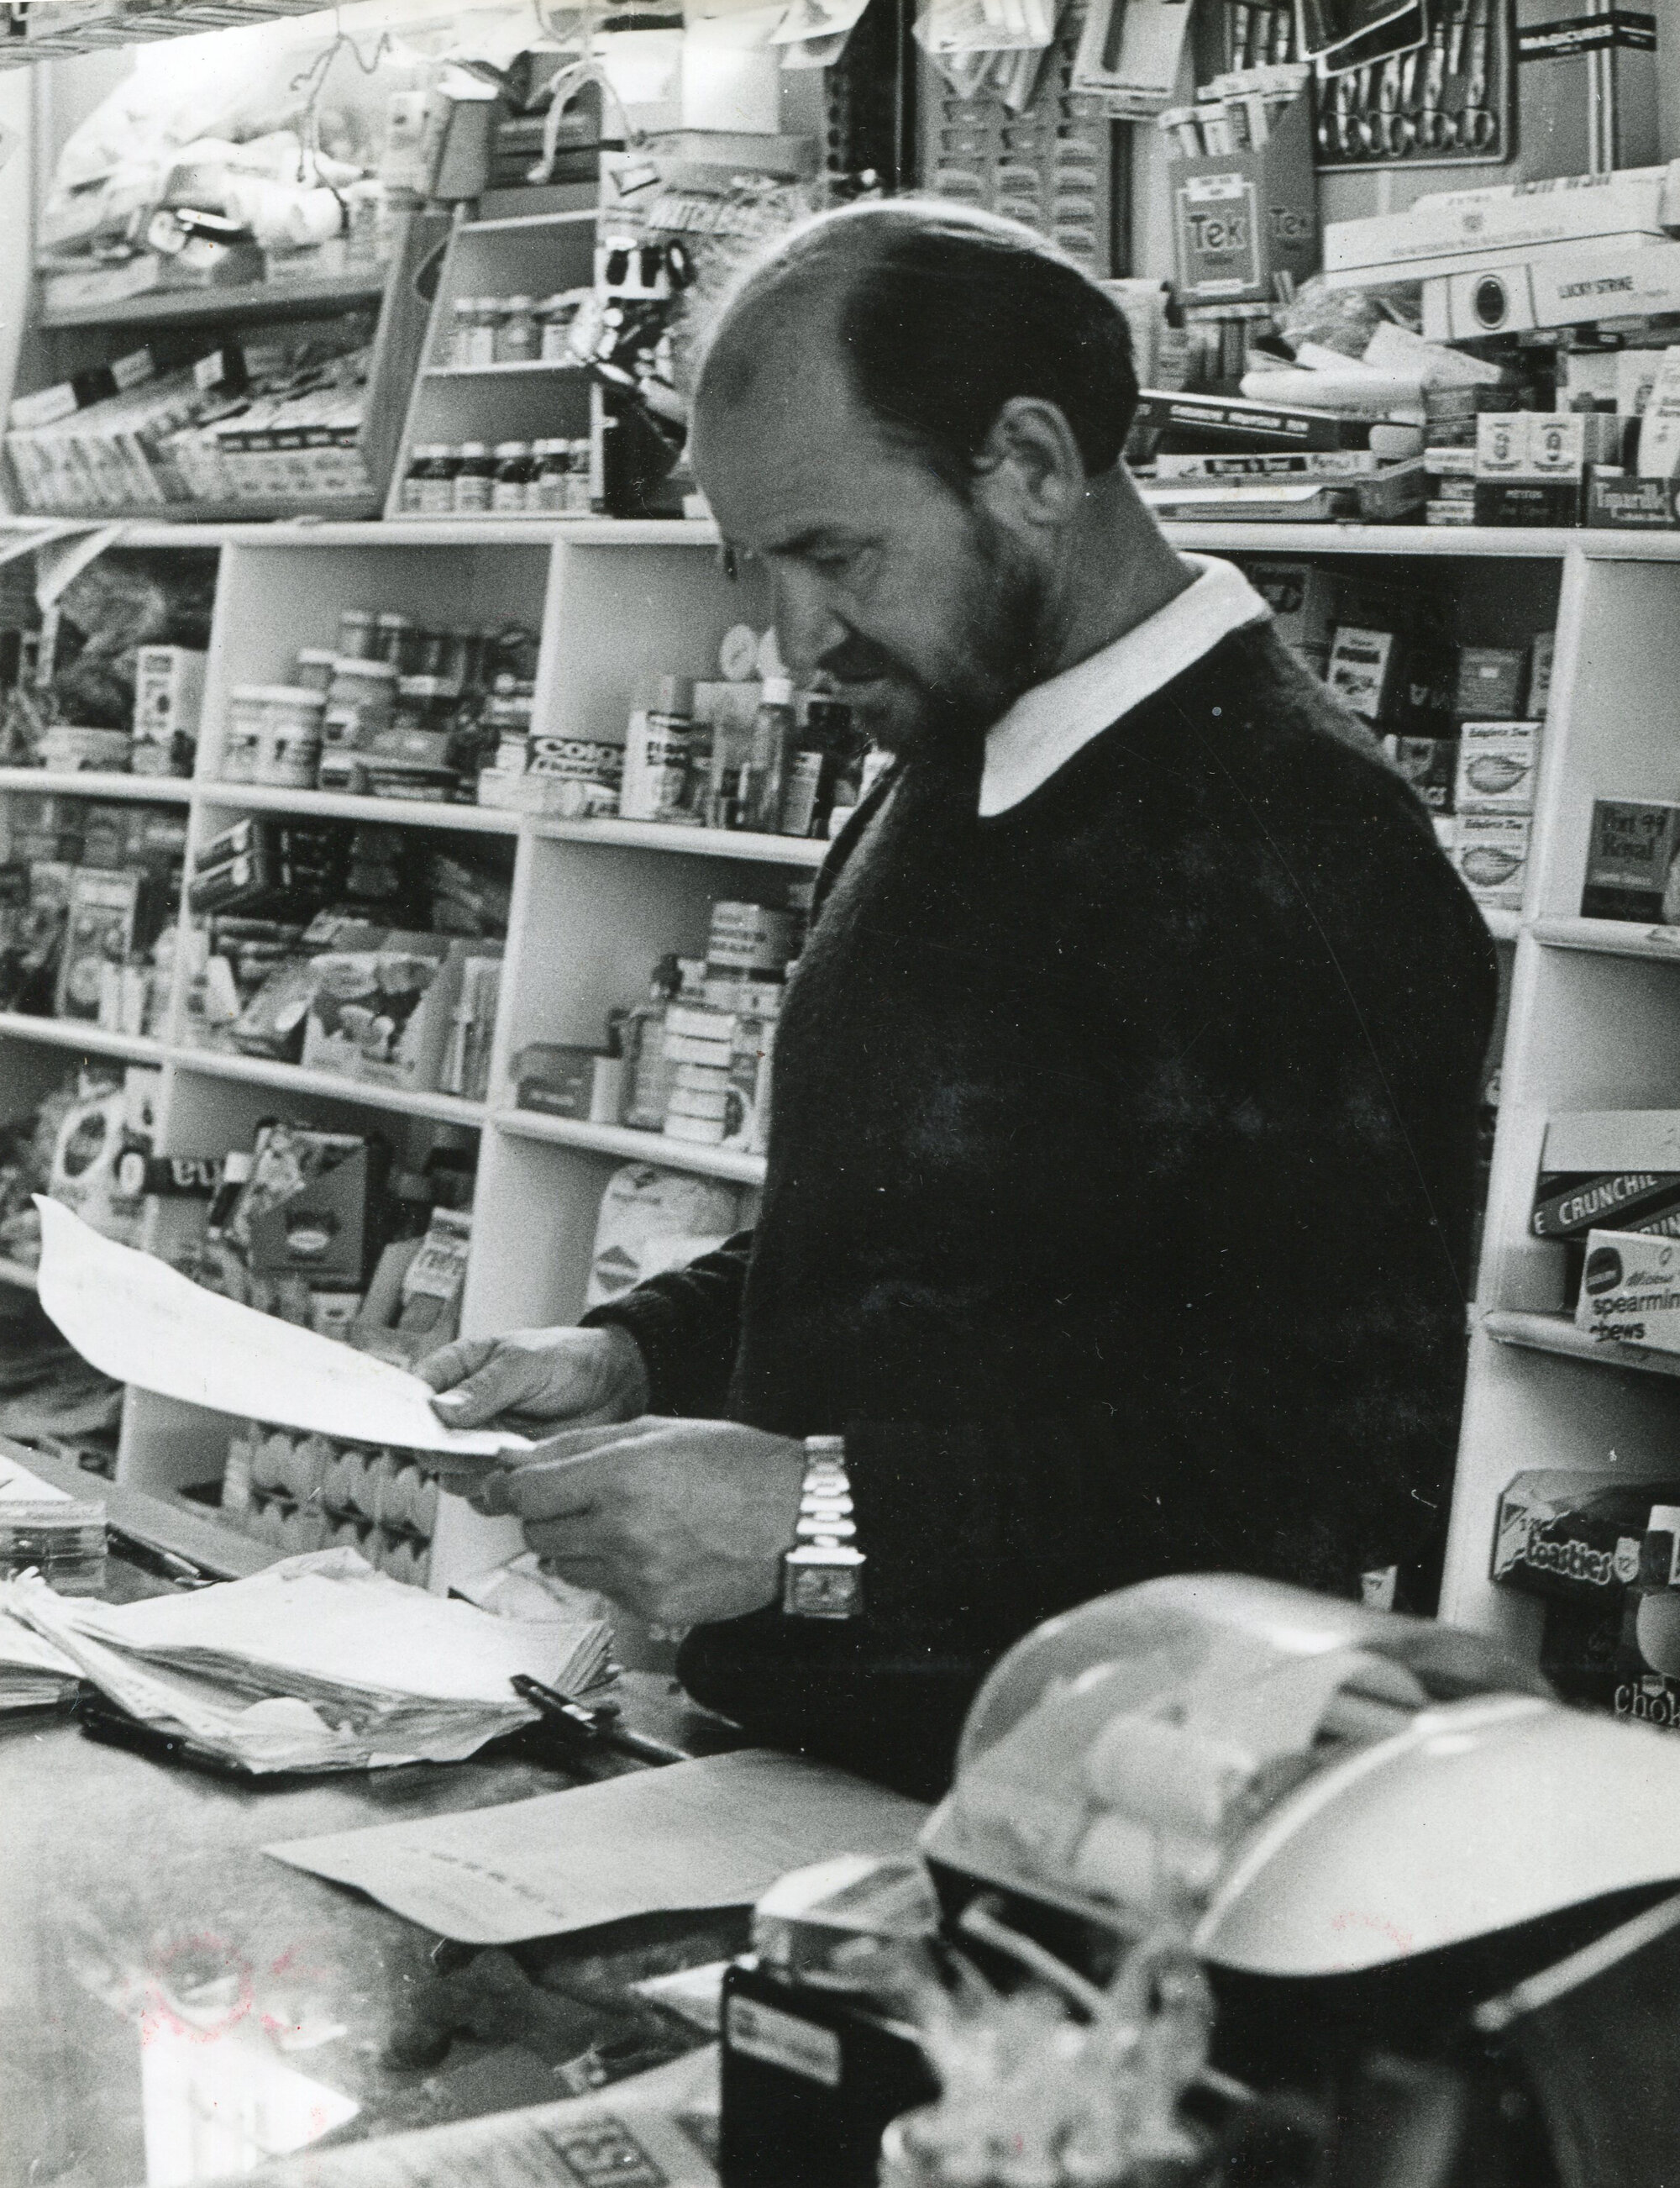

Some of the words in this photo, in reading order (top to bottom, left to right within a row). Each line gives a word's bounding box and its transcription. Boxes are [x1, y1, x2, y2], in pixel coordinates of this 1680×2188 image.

[1189, 210, 1247, 250] Tek
[1558, 281, 1593, 298] LUCKY
[1597, 276, 1633, 294] STRIKE
[1559, 1175, 1658, 1225] CRUNCHIE
